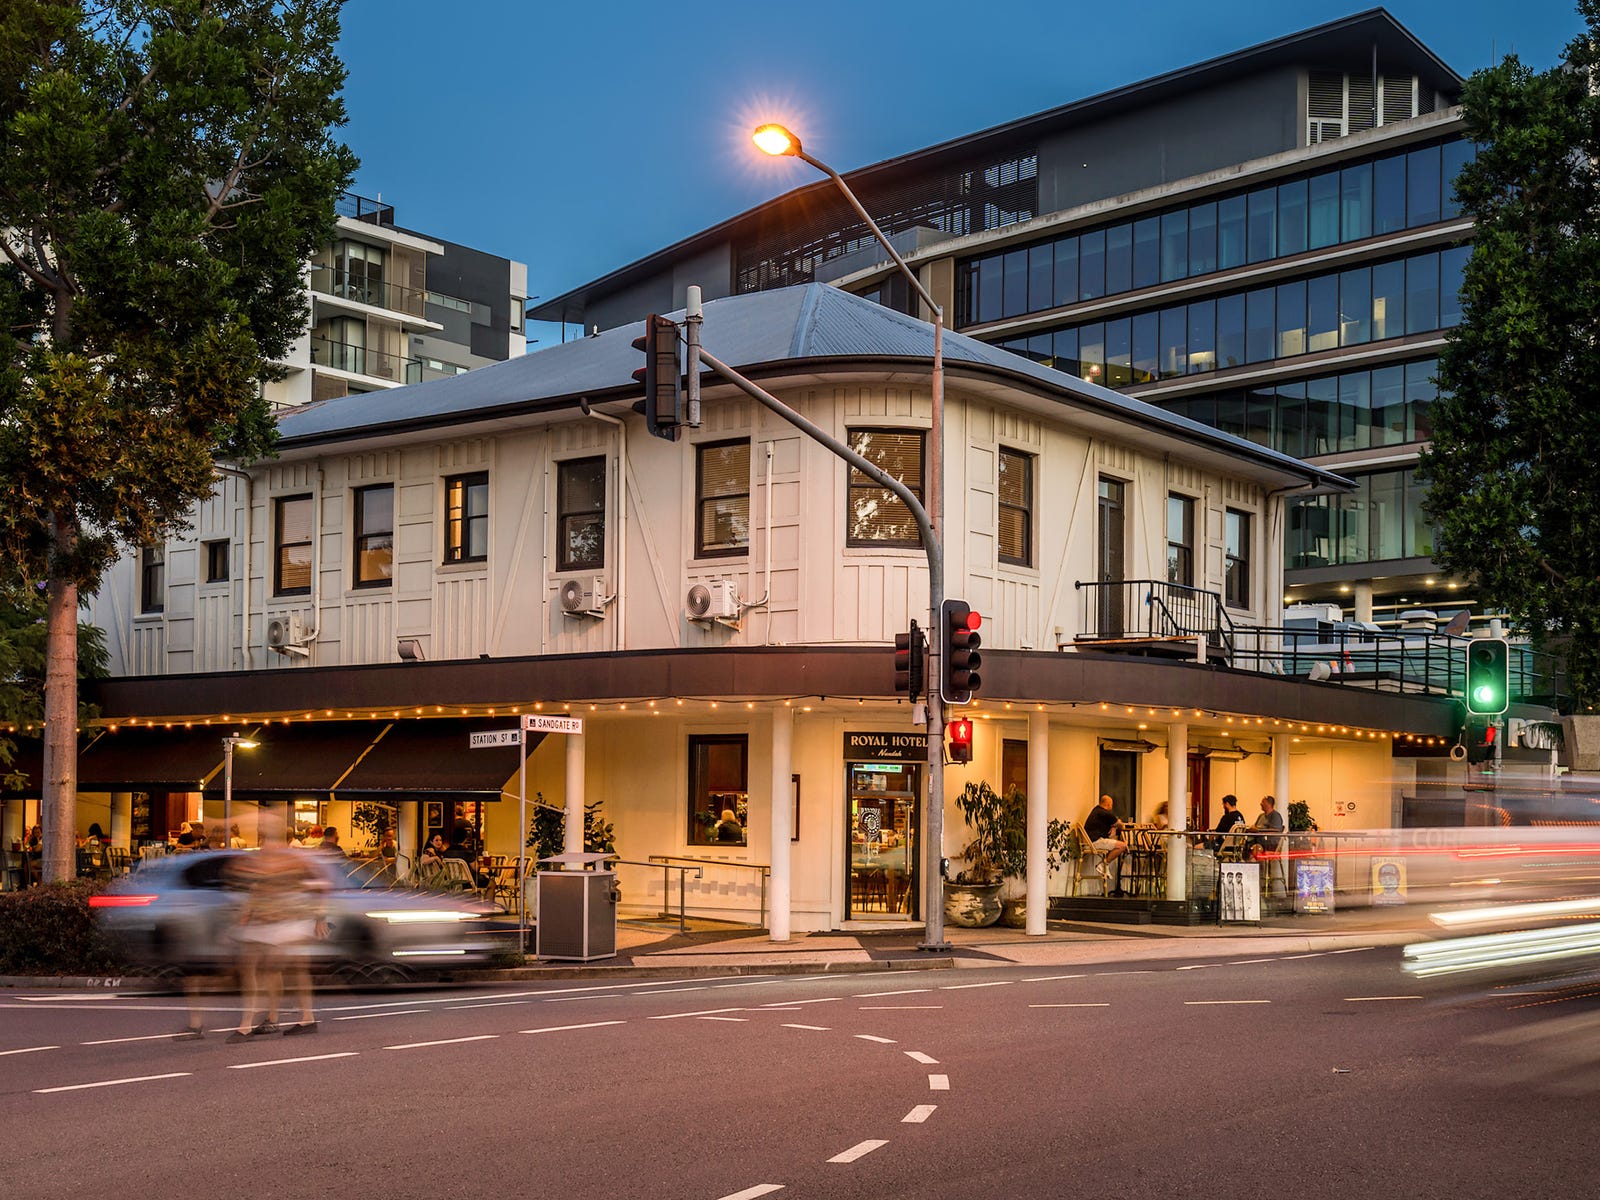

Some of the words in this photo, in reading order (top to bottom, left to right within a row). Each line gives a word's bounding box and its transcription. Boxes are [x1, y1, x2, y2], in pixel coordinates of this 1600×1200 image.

[537, 718, 571, 730] SANDGATE
[472, 734, 497, 745] STATION
[500, 733, 508, 743] ST
[851, 735, 888, 746] ROYAL
[892, 736, 928, 747] HOTEL
